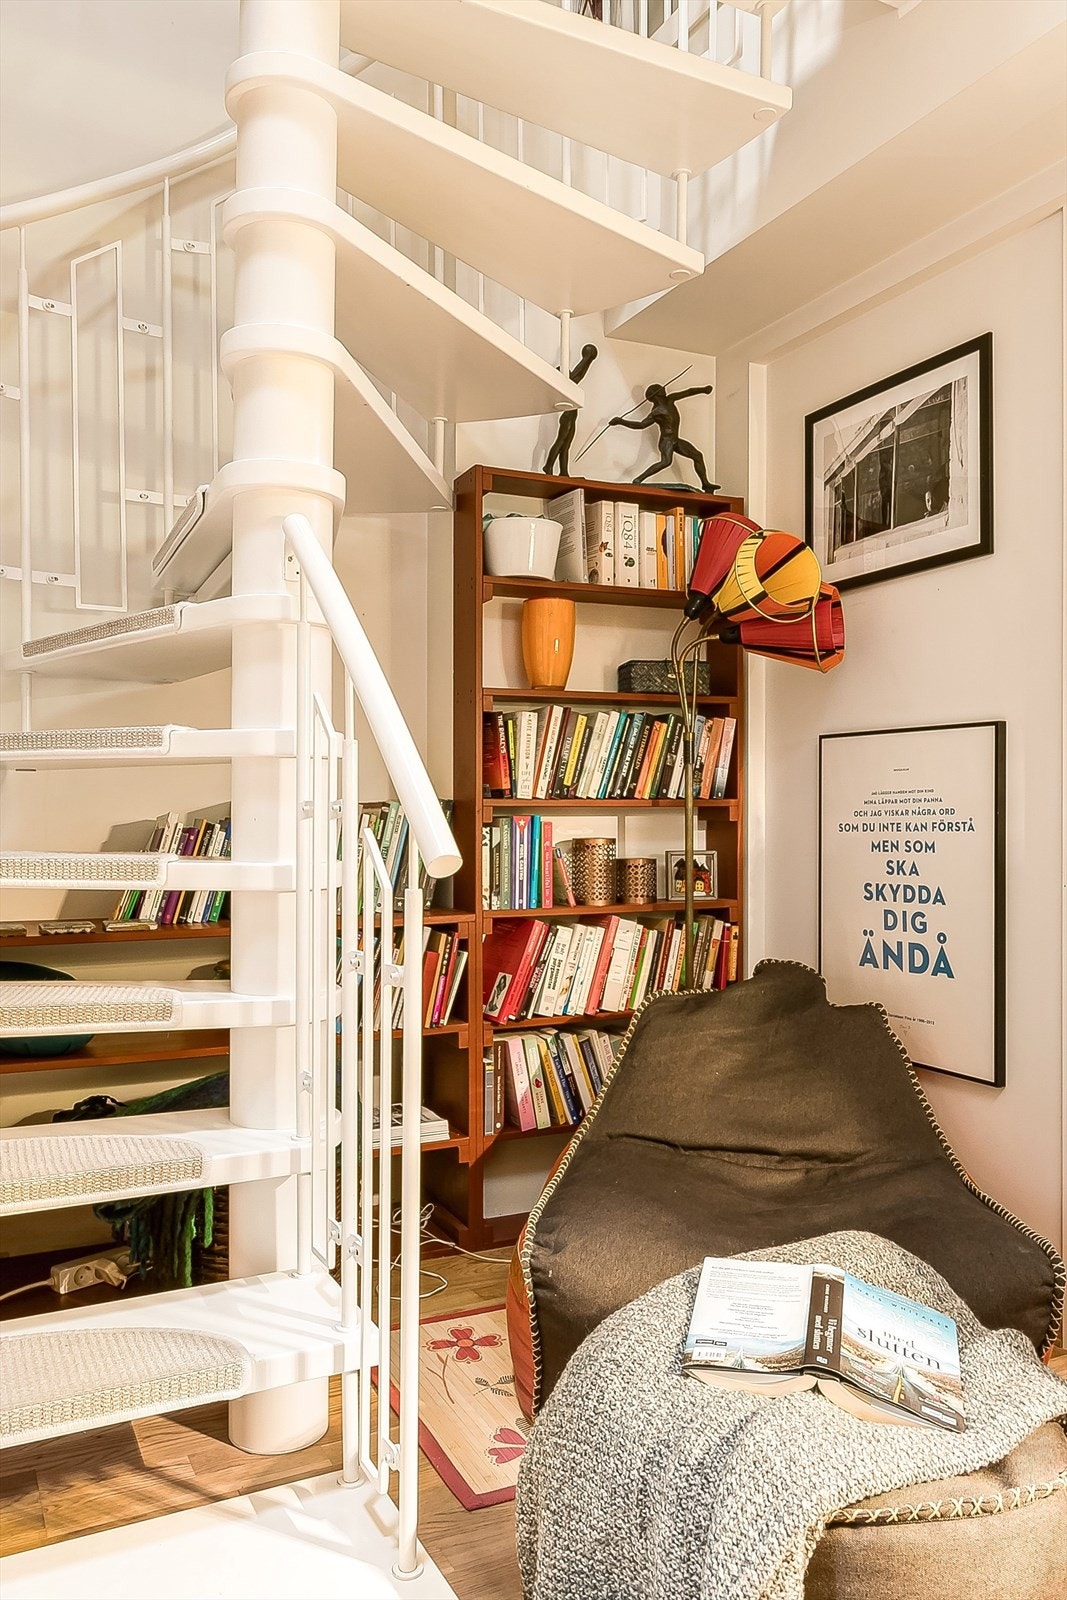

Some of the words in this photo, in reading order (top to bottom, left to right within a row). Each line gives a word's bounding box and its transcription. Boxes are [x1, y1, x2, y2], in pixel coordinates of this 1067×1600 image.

[621, 514, 633, 549] 1Q84
[498, 727, 506, 754] RADLEYS
[557, 735, 572, 779] TERAPEUTEN
[912, 807, 936, 816] NÅGRA
[839, 823, 859, 832] SOM
[862, 823, 875, 832] DU
[879, 822, 901, 832] INTE
[906, 822, 927, 832] KAN
[932, 817, 975, 832] FÖRSTÅ
[871, 840, 899, 852] MEN
[904, 840, 935, 853] SOM
[886, 860, 919, 876] SKA
[864, 883, 946, 905] SKYDDA
[884, 909, 927, 934] DIG
[859, 929, 954, 979] ÄNDÅ
[814, 1315, 824, 1329] med
[891, 1303, 949, 1329] WHITAKER
[812, 1328, 824, 1350] slutten
[824, 1325, 837, 1354] begynner
[857, 1327, 941, 1370] slutten
[884, 1331, 915, 1349] med
